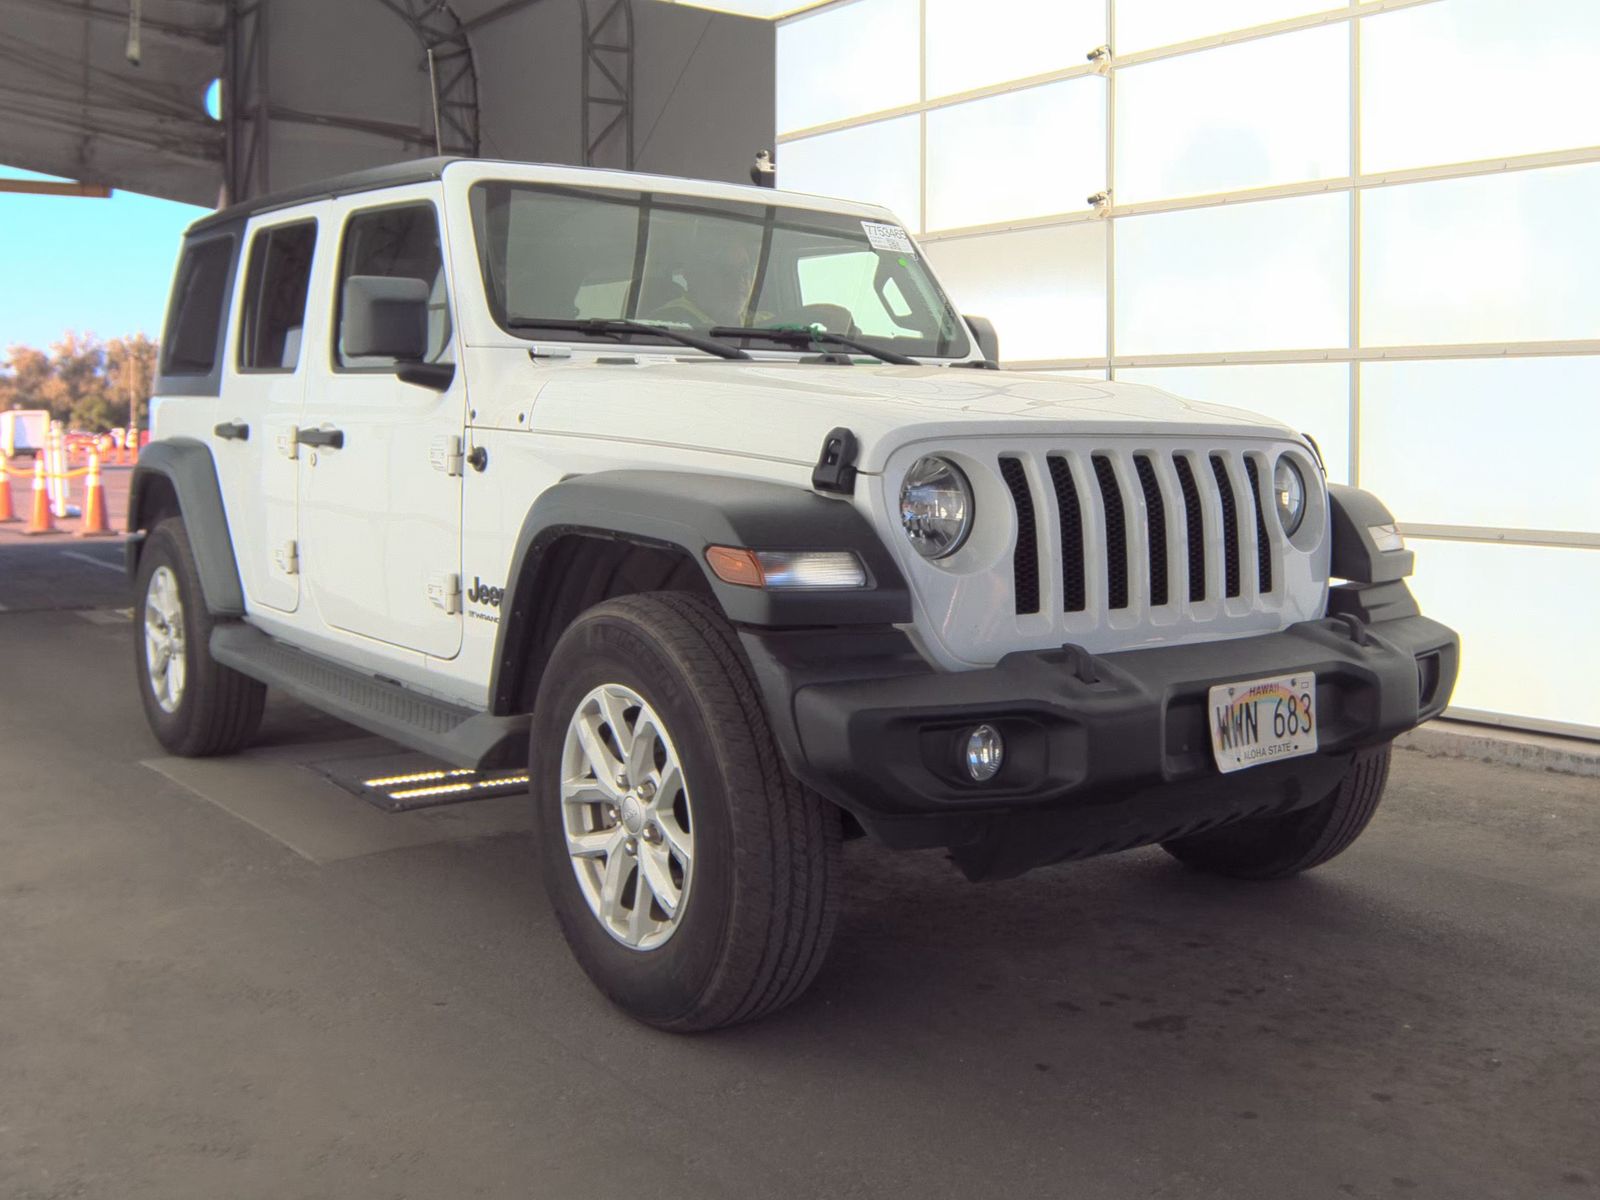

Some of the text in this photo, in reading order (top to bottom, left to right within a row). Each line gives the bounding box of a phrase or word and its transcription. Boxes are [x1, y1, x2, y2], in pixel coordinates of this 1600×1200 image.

[1249, 682, 1280, 697] HAWAII
[1216, 693, 1312, 751] WWN 683
[1244, 742, 1291, 760] ALOHA STATE
